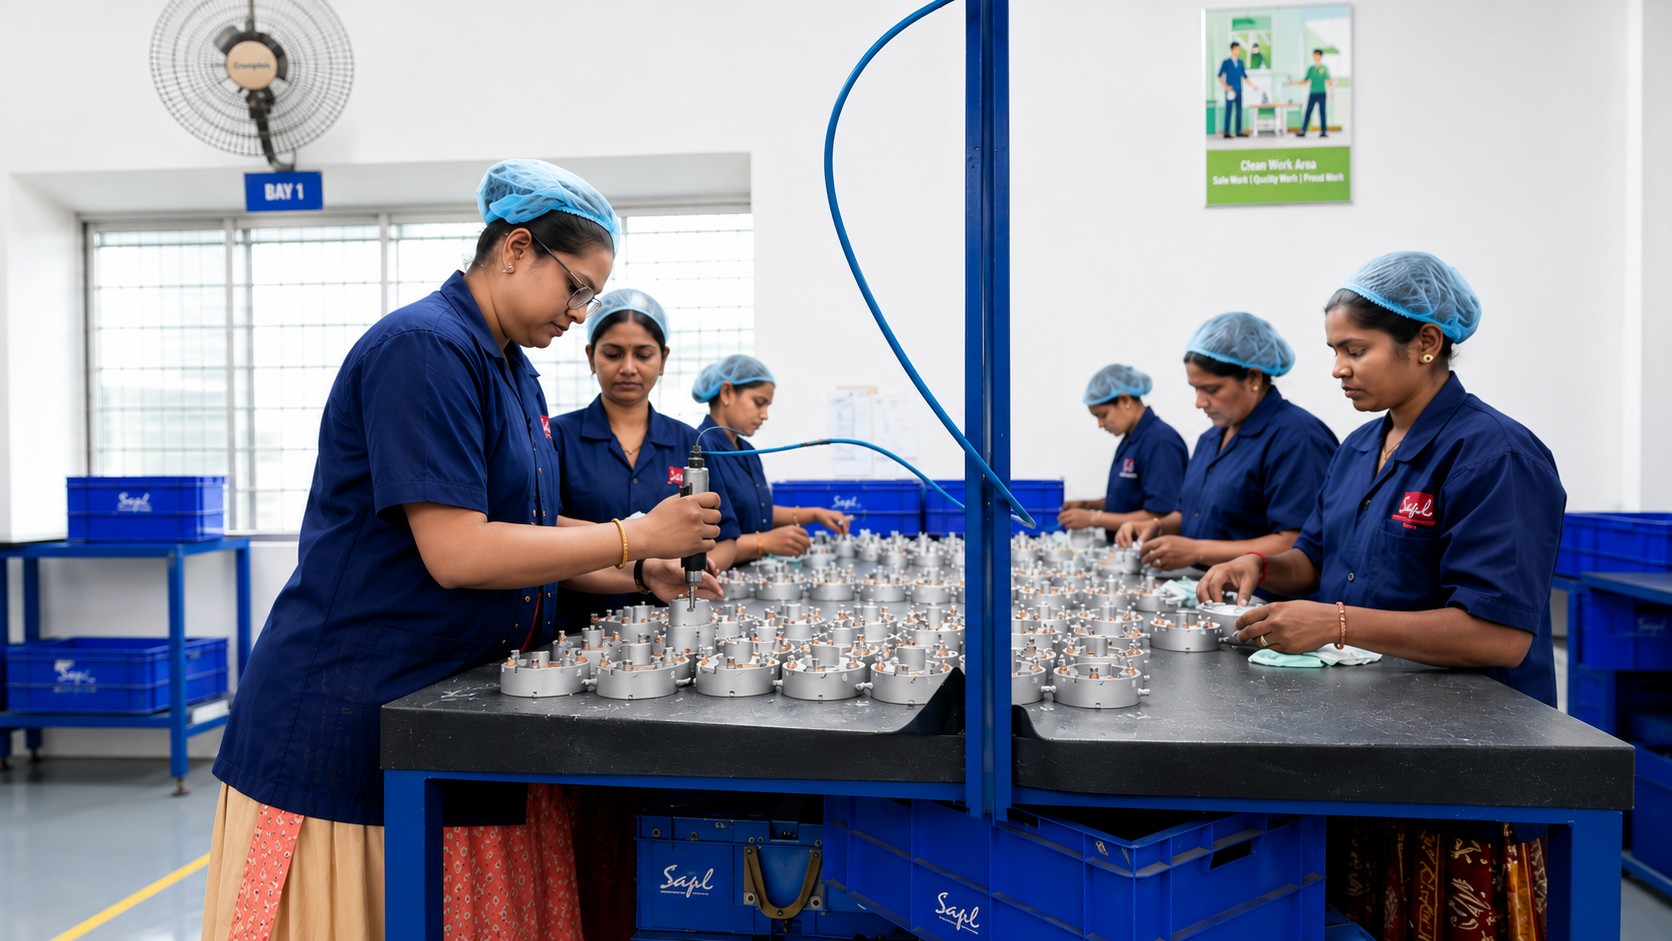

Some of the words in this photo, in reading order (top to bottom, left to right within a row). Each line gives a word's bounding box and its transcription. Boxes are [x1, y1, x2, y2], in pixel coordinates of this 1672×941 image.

[1240, 160, 1267, 171] Clean
[1268, 159, 1293, 170] Work
[1295, 158, 1316, 170] Area
[1212, 175, 1229, 185] Safe
[1230, 175, 1249, 185] Work
[1253, 174, 1278, 185] Quality
[1279, 173, 1298, 183] Work
[1303, 173, 1325, 183] Proud
[1325, 172, 1344, 182] Work
[264, 182, 294, 201] BAY
[295, 182, 304, 201] 1
[659, 864, 714, 898] Sapl
[934, 891, 980, 931] Sapl
